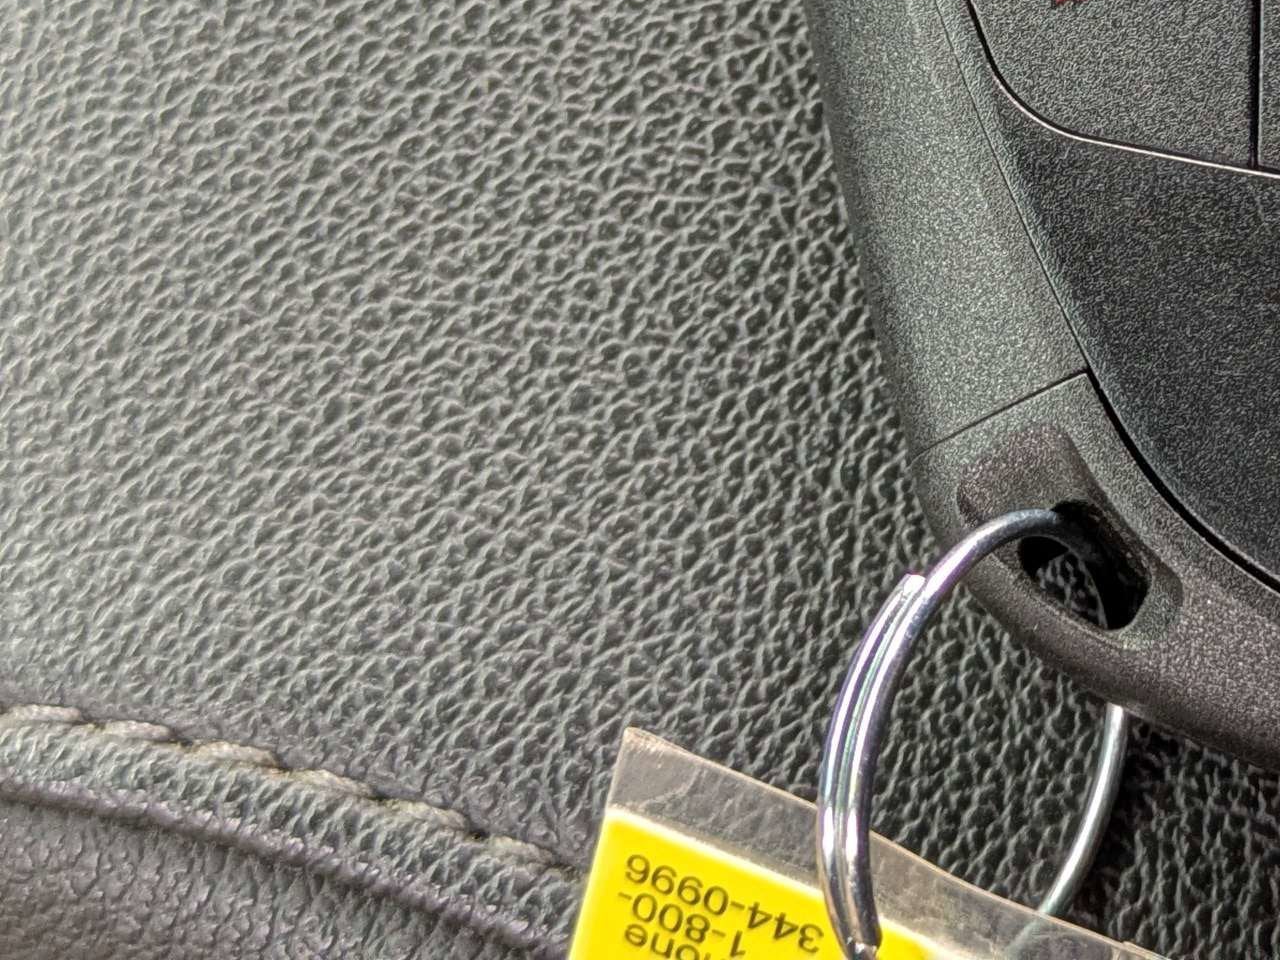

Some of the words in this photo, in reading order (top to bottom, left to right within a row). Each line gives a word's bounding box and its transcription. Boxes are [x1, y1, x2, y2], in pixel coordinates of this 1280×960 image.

[618, 892, 746, 959] 1-800-
[625, 854, 824, 954] 344-0996
[624, 923, 726, 960] one
